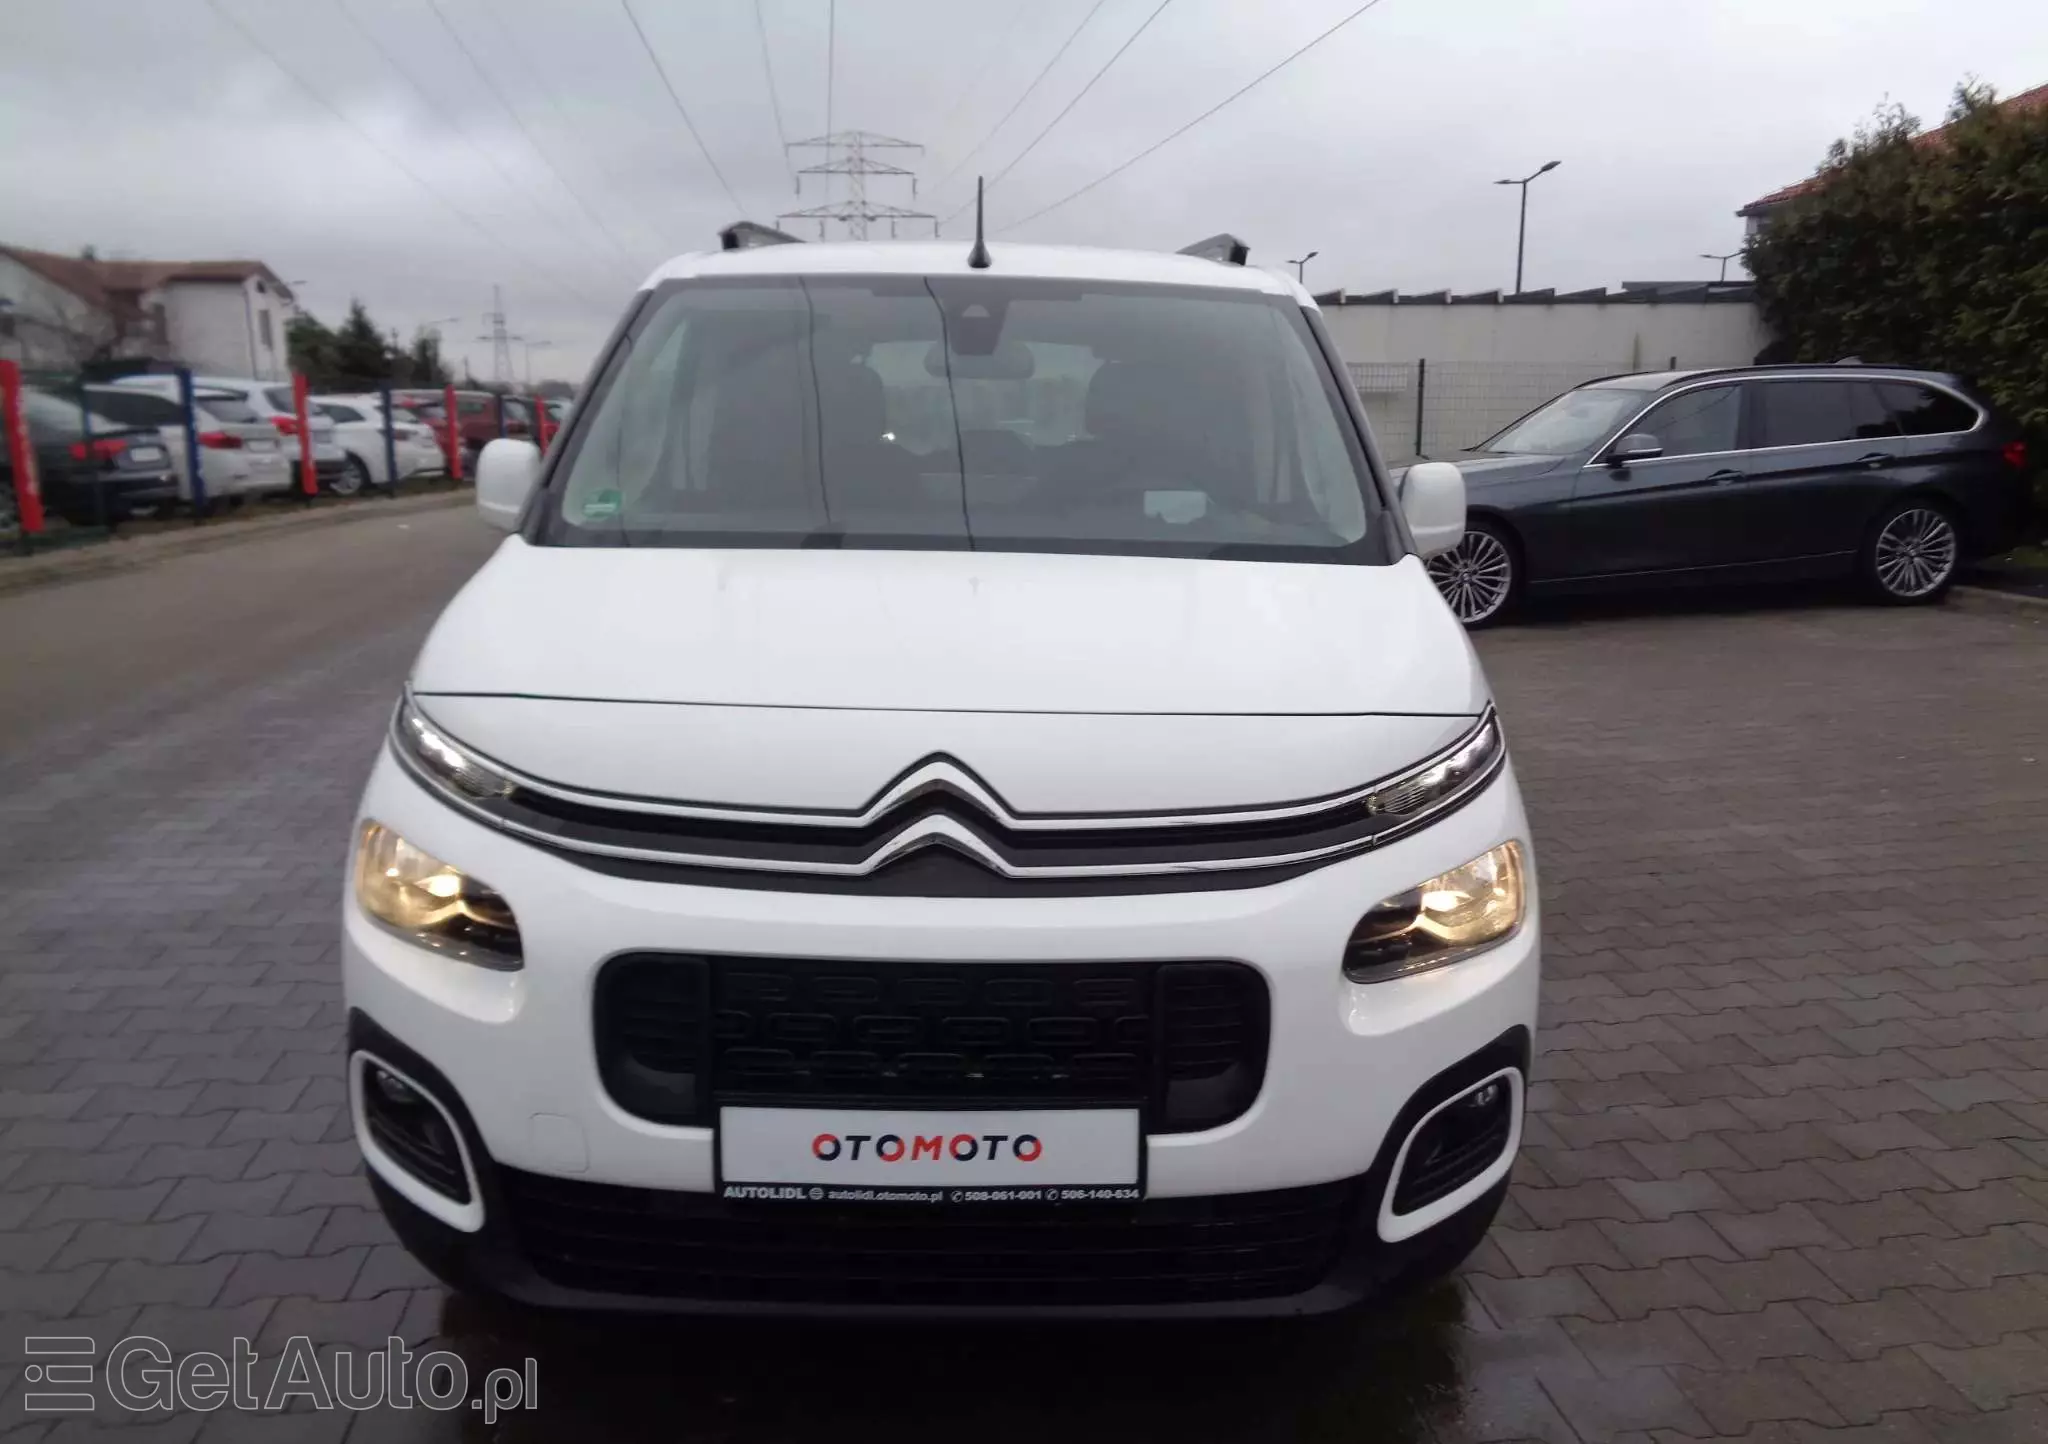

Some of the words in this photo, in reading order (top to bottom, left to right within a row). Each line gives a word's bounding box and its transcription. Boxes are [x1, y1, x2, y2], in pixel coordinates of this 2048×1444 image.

[812, 1134, 1042, 1162] OTOMOTO
[723, 1186, 807, 1200] AUTOLIDL
[828, 1189, 943, 1203] autolidl.otomoto.pl
